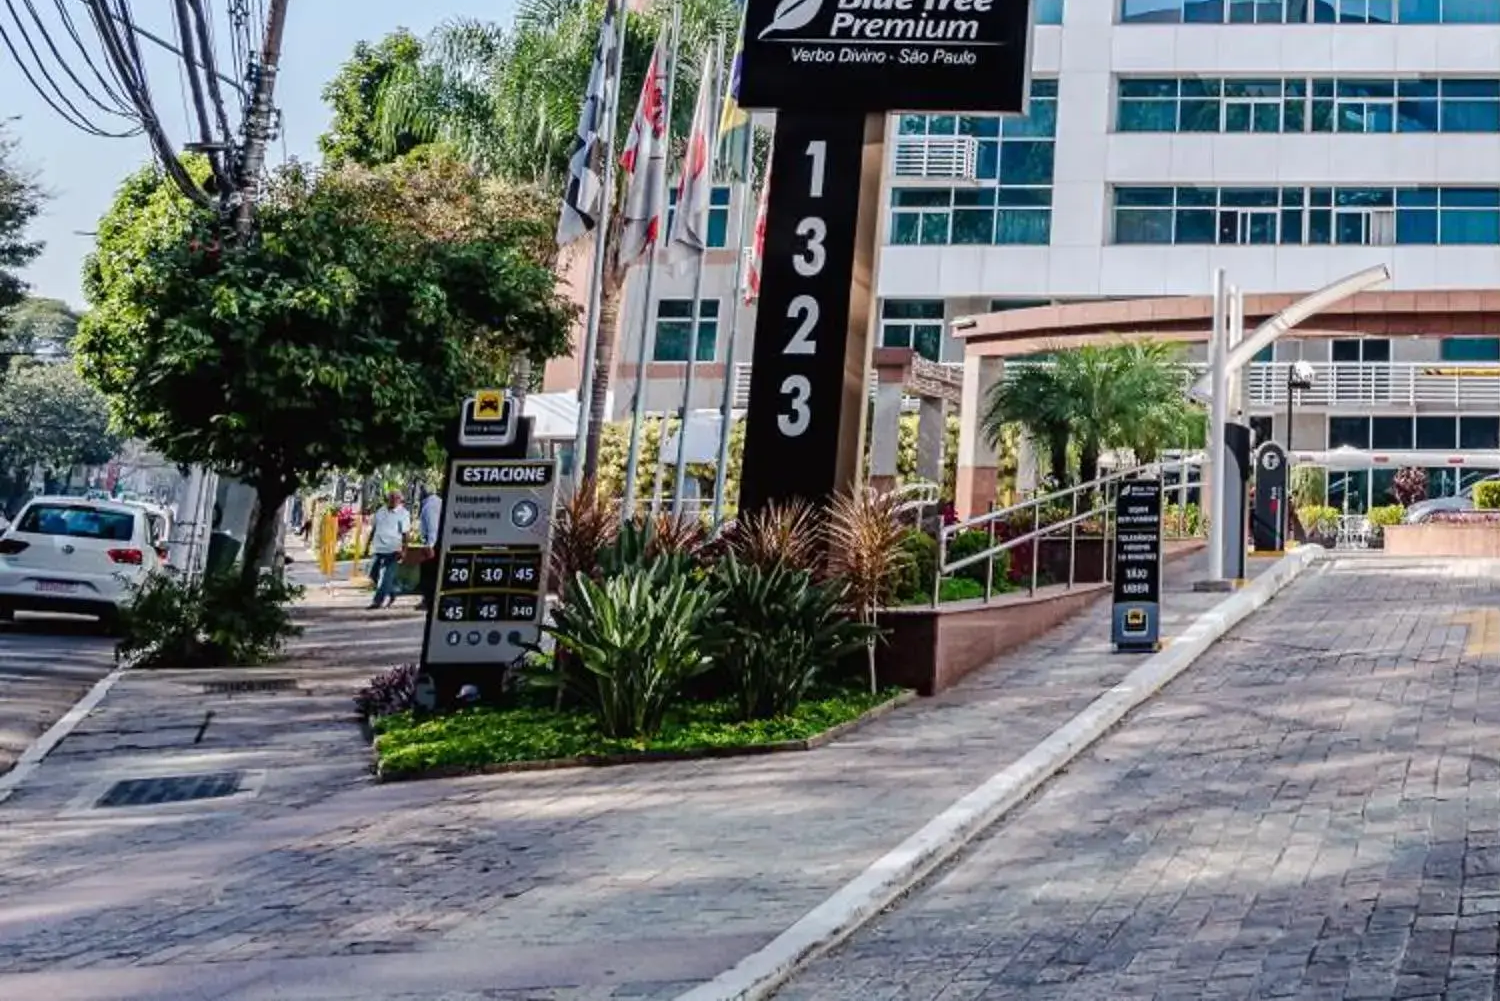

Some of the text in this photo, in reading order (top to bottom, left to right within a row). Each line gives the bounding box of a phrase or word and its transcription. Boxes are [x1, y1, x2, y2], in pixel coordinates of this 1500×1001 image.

[829, 12, 979, 39] Premium
[791, 48, 977, 64] Verbo Divino São Paulo
[463, 466, 546, 482] ESTACIONE
